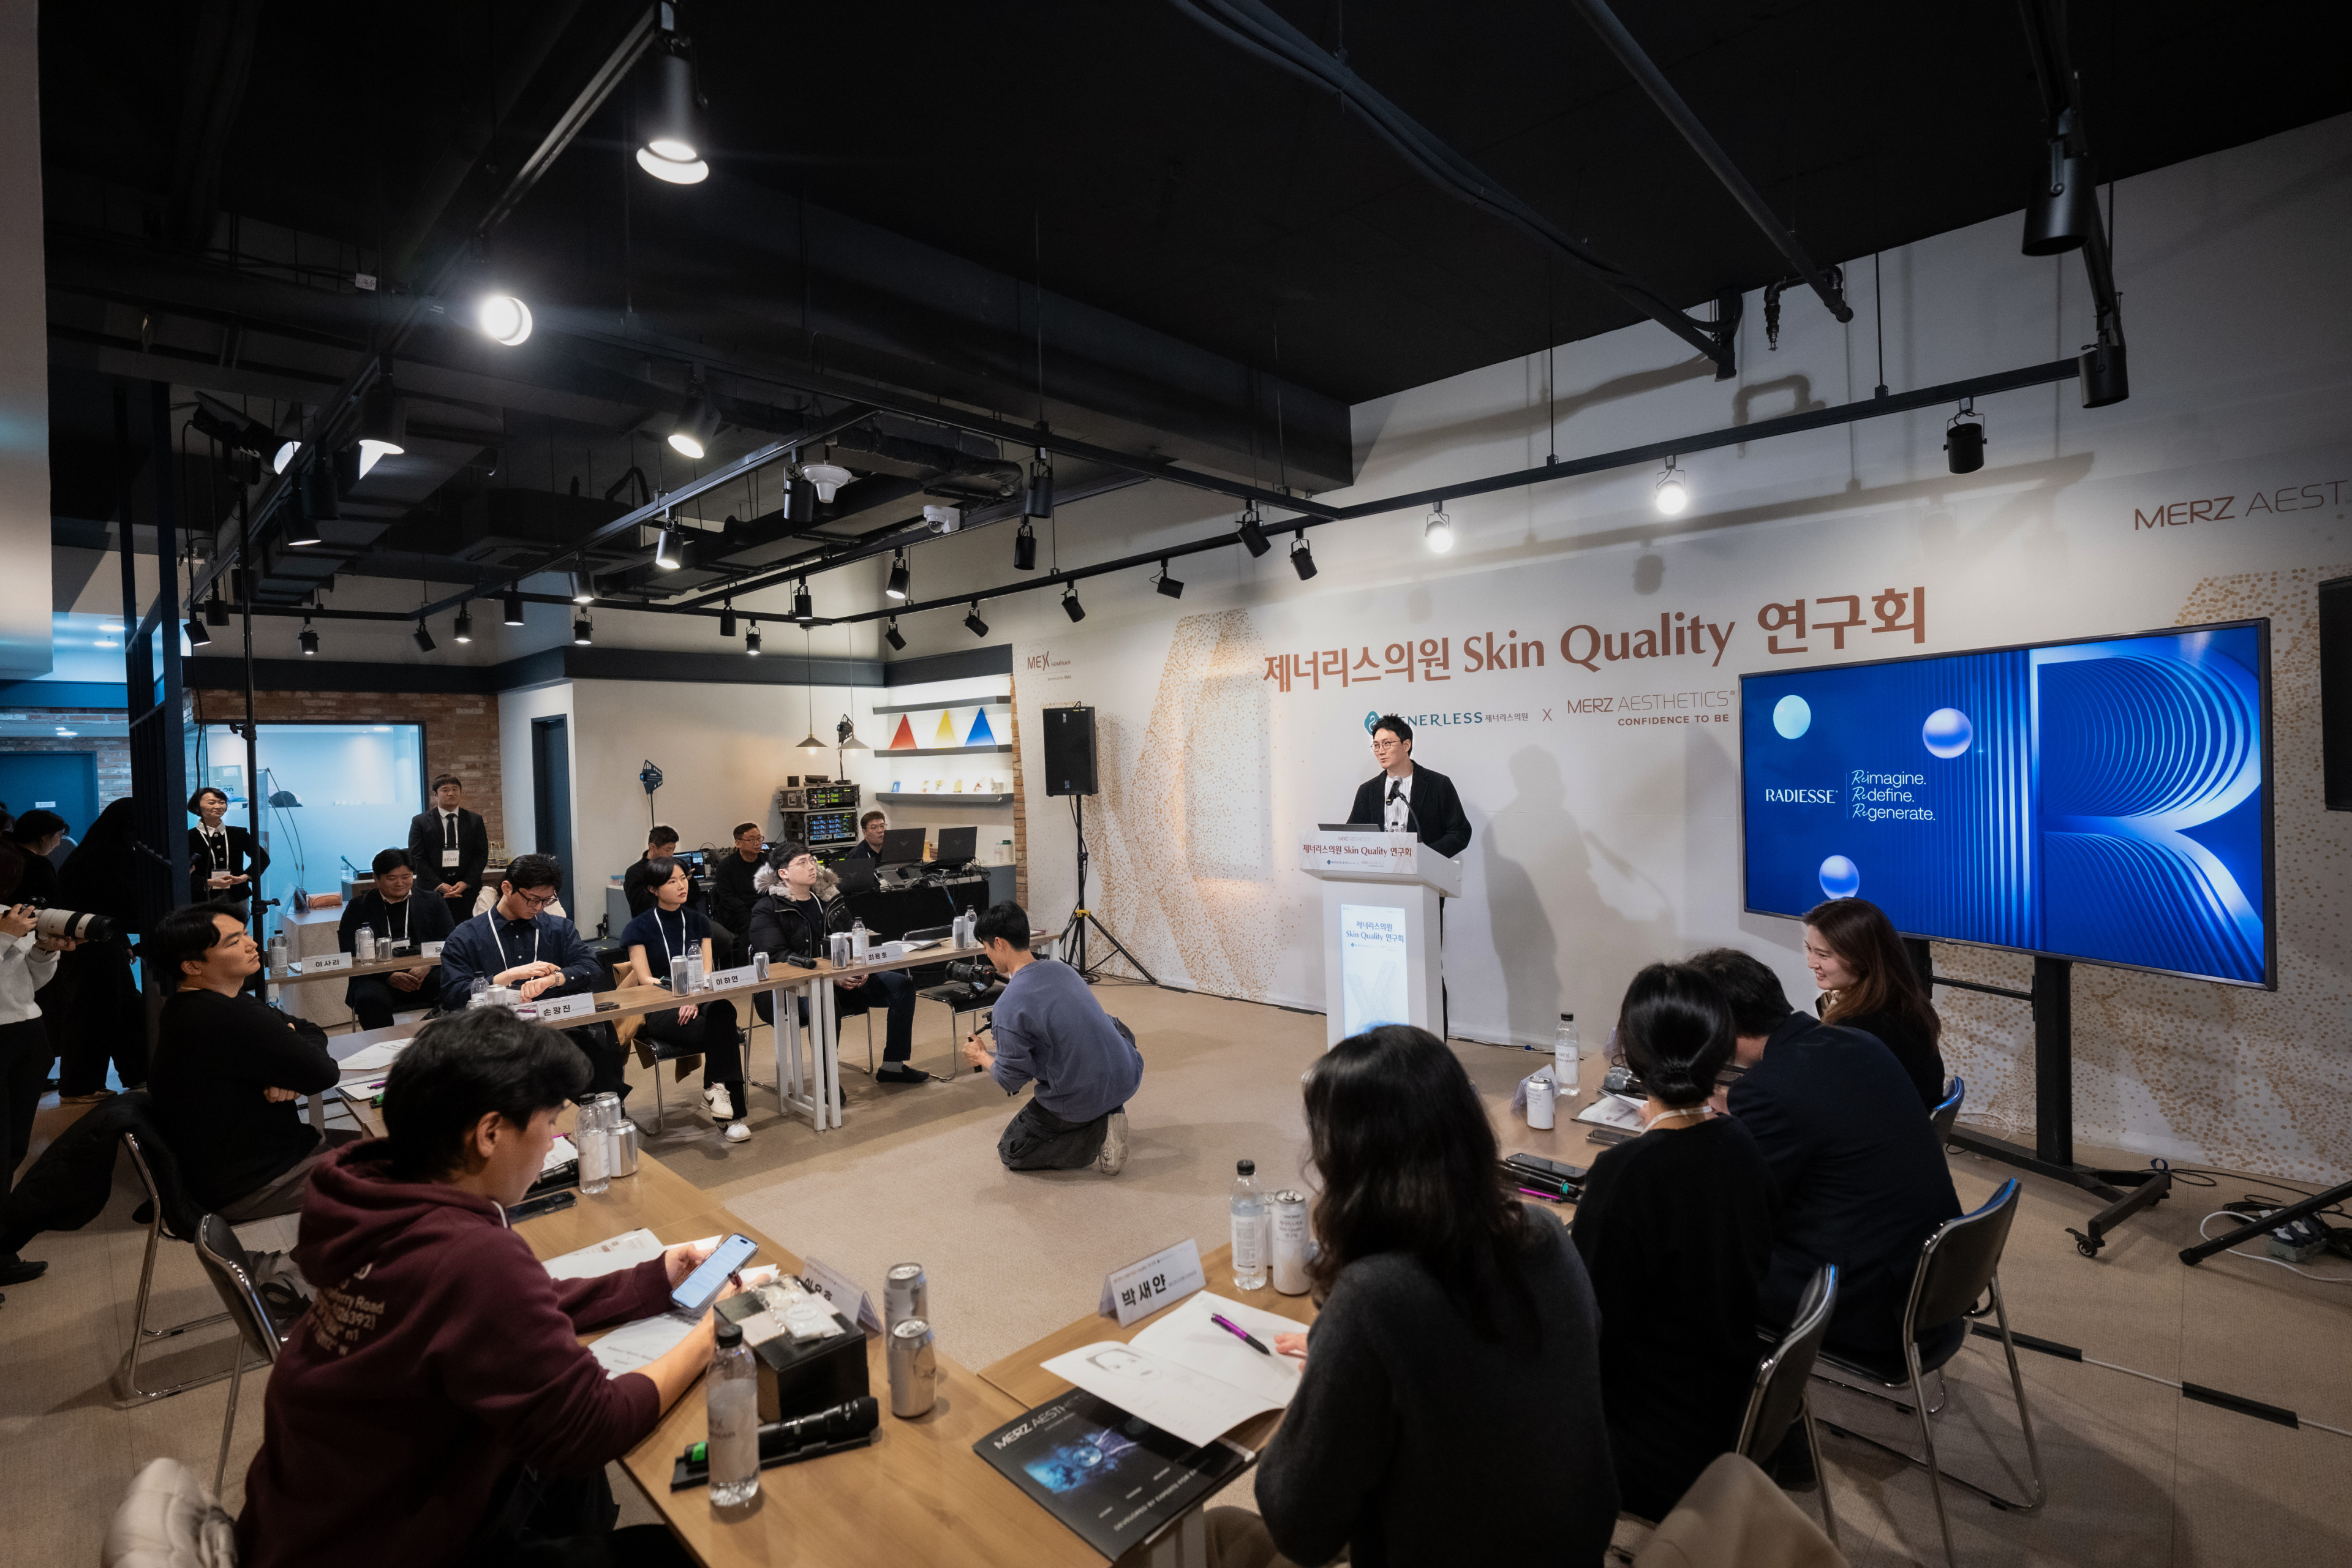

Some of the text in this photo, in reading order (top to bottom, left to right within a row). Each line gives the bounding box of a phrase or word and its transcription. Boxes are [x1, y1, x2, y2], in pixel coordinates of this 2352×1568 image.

[2135, 480, 2348, 530] MERZ AEST
[1263, 586, 1926, 693] 제너리스의원 Skin Quality 연구회
[1027, 650, 1050, 671] MEX
[1567, 697, 1614, 714] MERZ
[1402, 712, 1483, 727] NERLESS
[1485, 712, 1529, 723] 제너리스의원
[1618, 714, 1729, 726] CONFIDENCE TO BE
[1851, 769, 1927, 788] Reimagine.
[1852, 786, 1915, 802] Redefine.
[1852, 803, 1936, 821] Regenerate.
[1303, 844, 1412, 858] 제너리스의원 Skin Quality 연구회
[1356, 921, 1393, 932] 제너리스의원
[1360, 932, 1384, 942] Quality
[1385, 933, 1404, 943] 연구회
[315, 959, 340, 967] 이사라
[543, 1005, 571, 1017] 손광진
[993, 1422, 1033, 1450] MERZ
